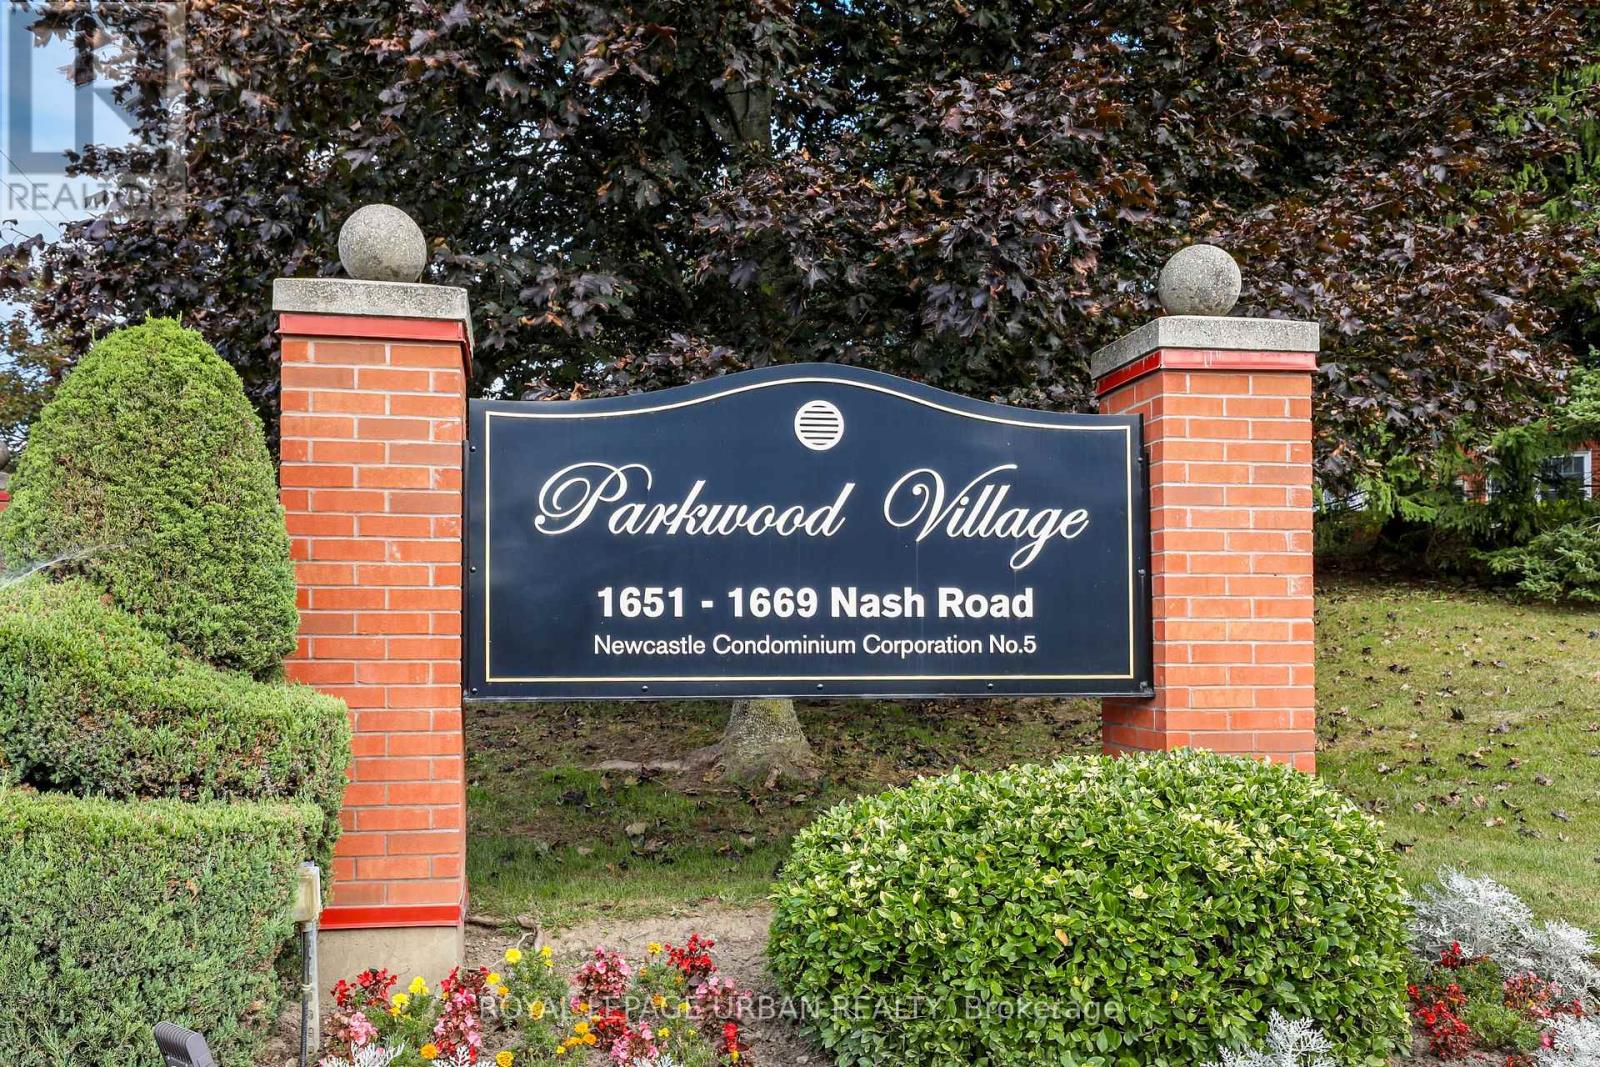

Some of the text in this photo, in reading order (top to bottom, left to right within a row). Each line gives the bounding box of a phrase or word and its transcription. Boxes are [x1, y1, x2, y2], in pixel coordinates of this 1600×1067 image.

[534, 462, 1090, 571] Parkwood Village
[597, 586, 1034, 619] 1651 - 1669 Nash Road
[594, 633, 1038, 660] Newcastle Condominium Corporation No.5
